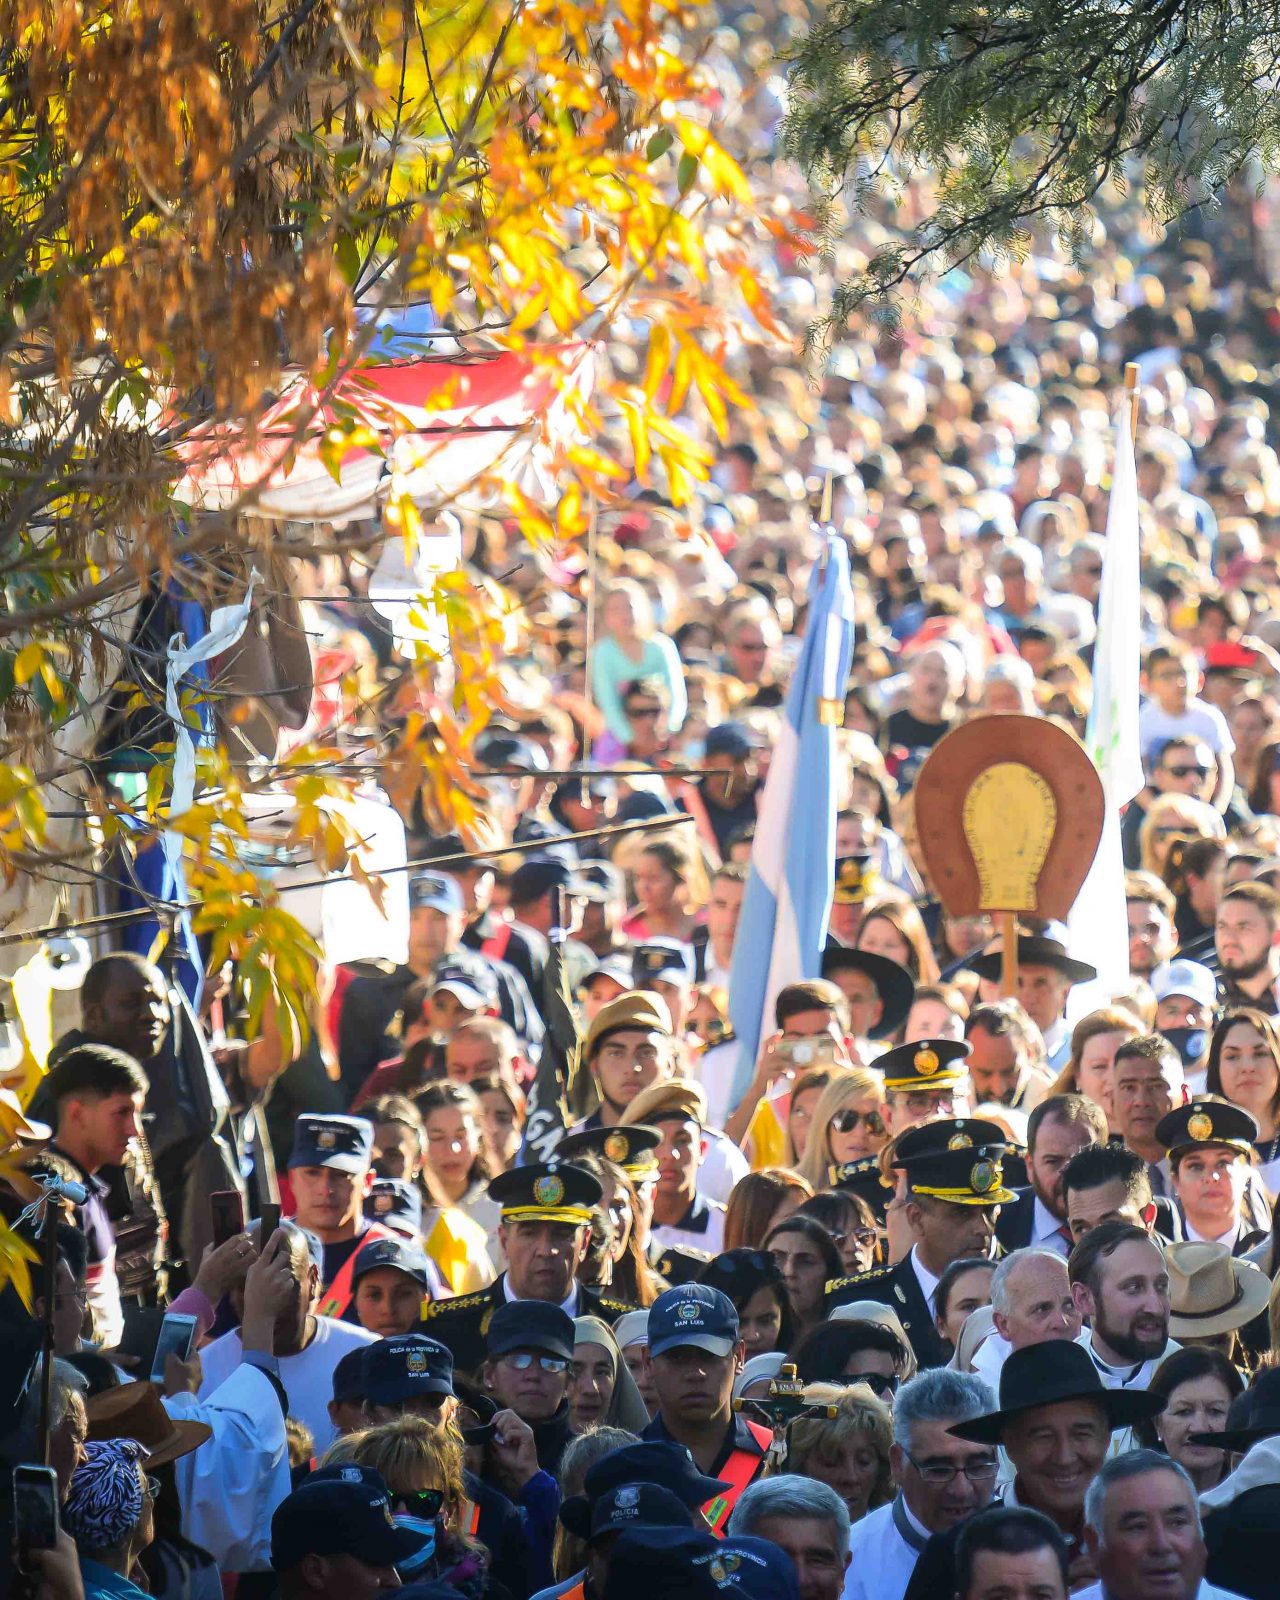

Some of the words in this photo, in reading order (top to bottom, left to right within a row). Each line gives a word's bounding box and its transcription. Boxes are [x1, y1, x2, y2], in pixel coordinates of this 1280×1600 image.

[674, 1320, 688, 1328] SAN
[610, 1508, 640, 1519] POLICIA
[734, 1550, 768, 1567] PROVINCIA
